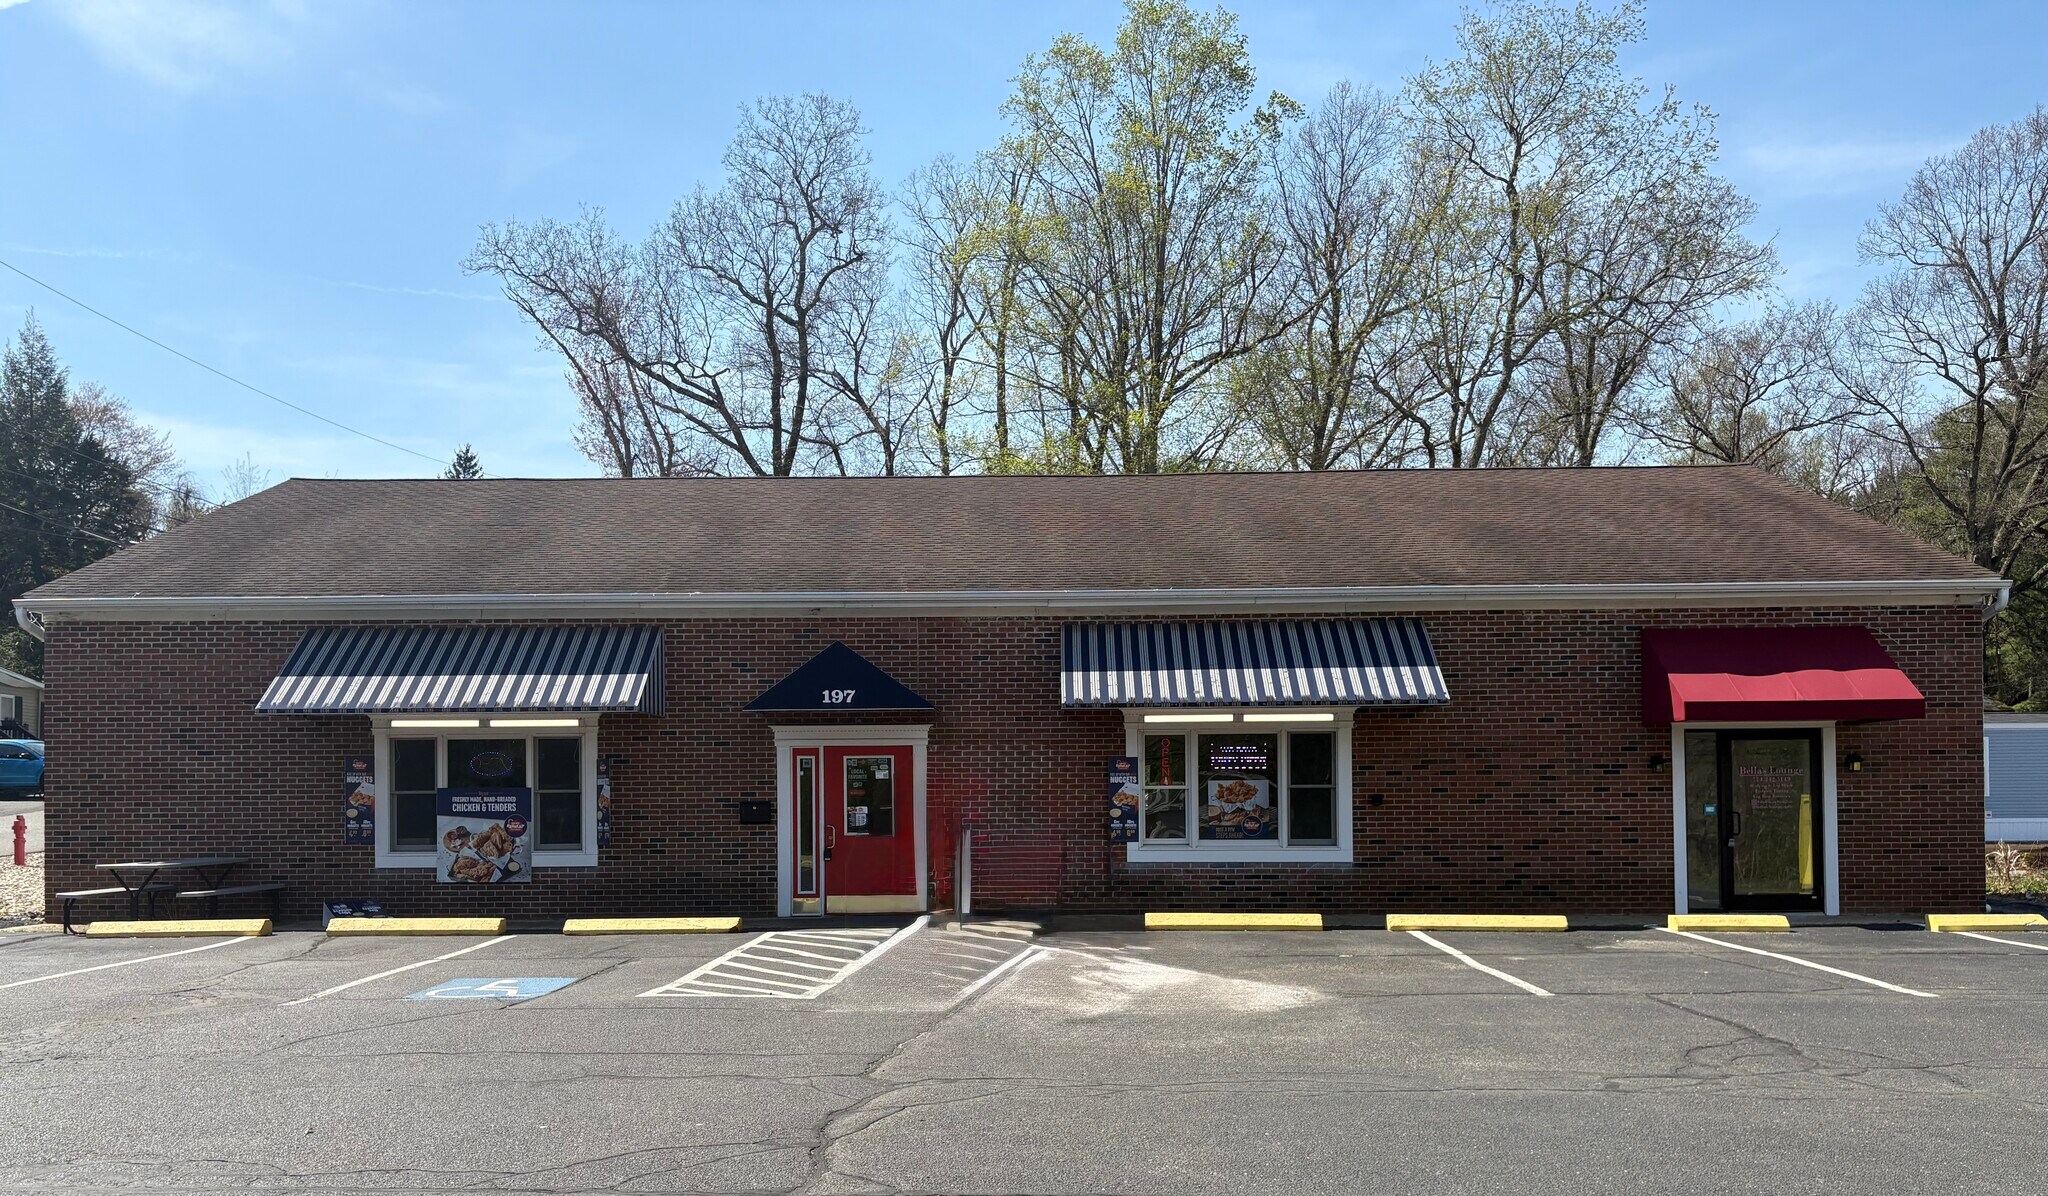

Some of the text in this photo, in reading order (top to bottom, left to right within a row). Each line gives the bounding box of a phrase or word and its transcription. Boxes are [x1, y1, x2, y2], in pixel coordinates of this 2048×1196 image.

[822, 689, 856, 703] 197
[1161, 738, 1170, 776] OPEN
[1769, 766, 1804, 776] Lounge
[452, 803, 517, 812] CHICKEN & TENDERS
